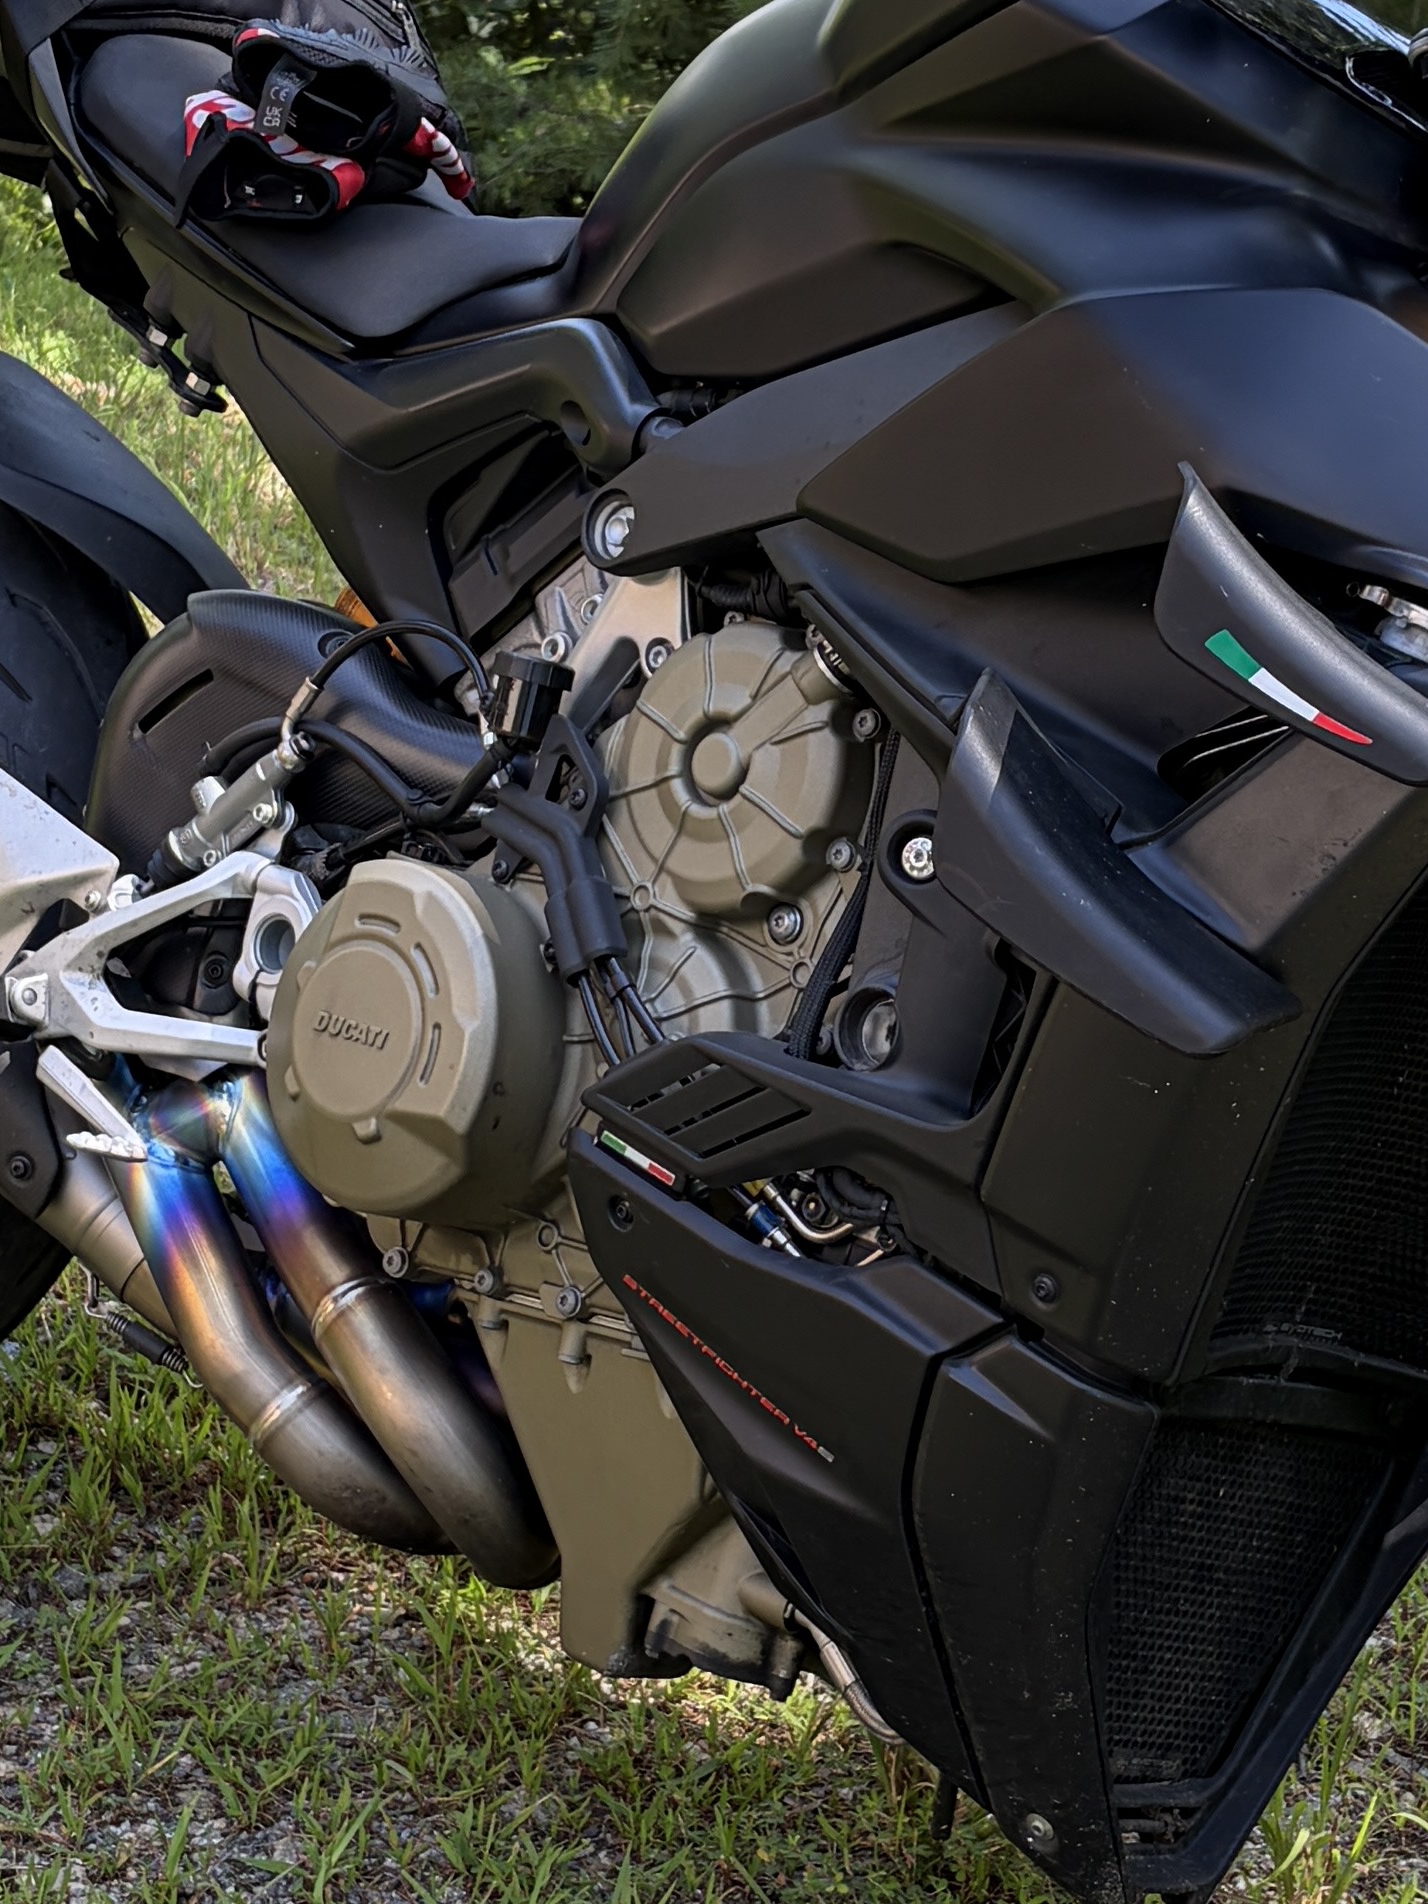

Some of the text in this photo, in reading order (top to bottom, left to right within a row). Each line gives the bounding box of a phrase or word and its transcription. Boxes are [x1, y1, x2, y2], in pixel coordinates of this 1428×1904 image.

[270, 86, 290, 102] CE
[313, 1010, 390, 1051] DUCATI
[623, 1274, 790, 1425] STREETFIGHTER
